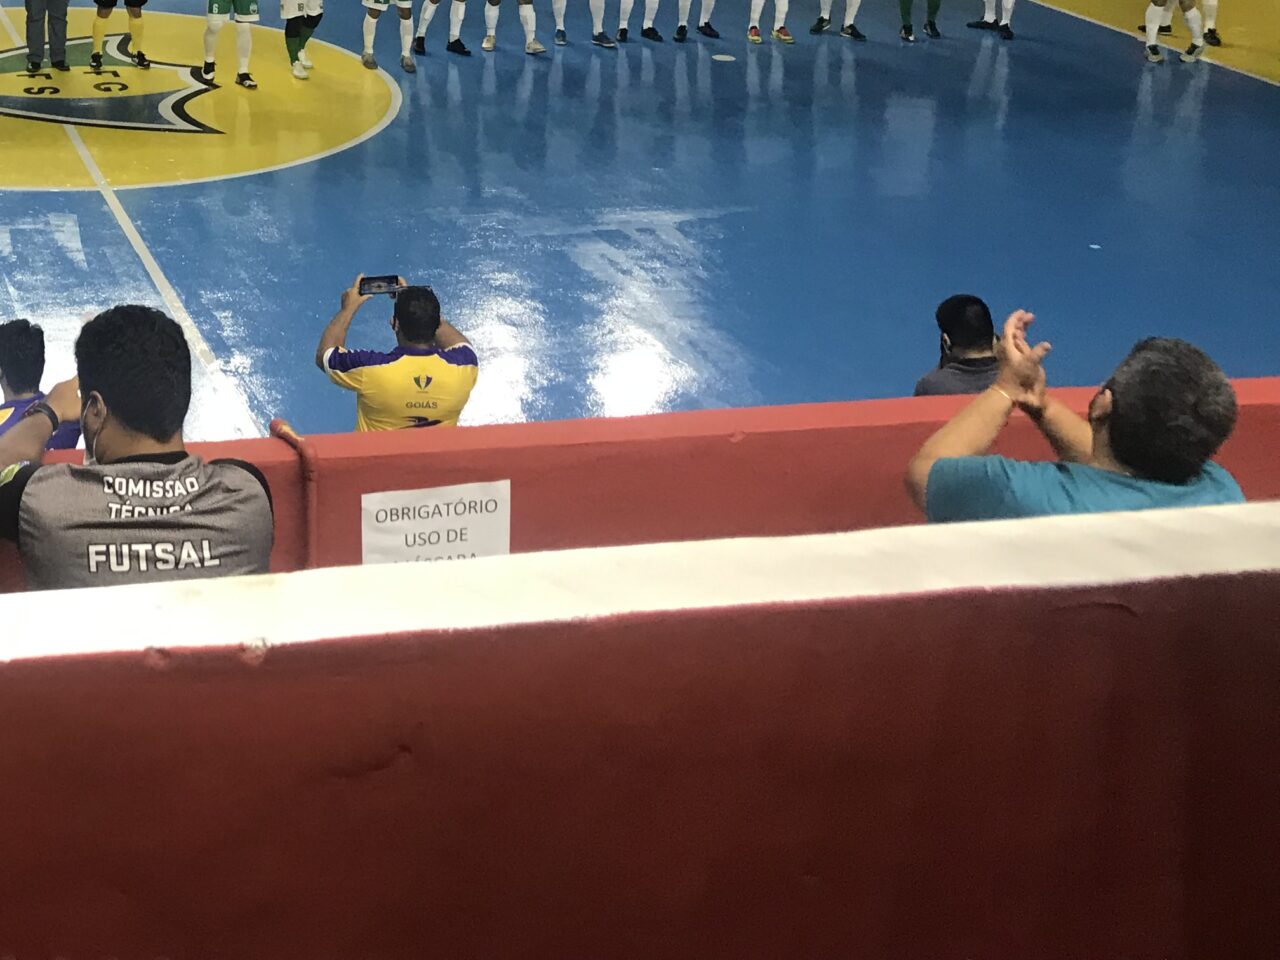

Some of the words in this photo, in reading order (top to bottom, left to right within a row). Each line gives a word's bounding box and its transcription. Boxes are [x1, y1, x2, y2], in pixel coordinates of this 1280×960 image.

[213, 3, 219, 14] 6
[405, 401, 438, 409] GOIÁS
[375, 497, 499, 524] OBRIGATÓRIO
[404, 530, 441, 548] USO
[446, 527, 468, 543] DE
[88, 539, 220, 572] FUTSAL
